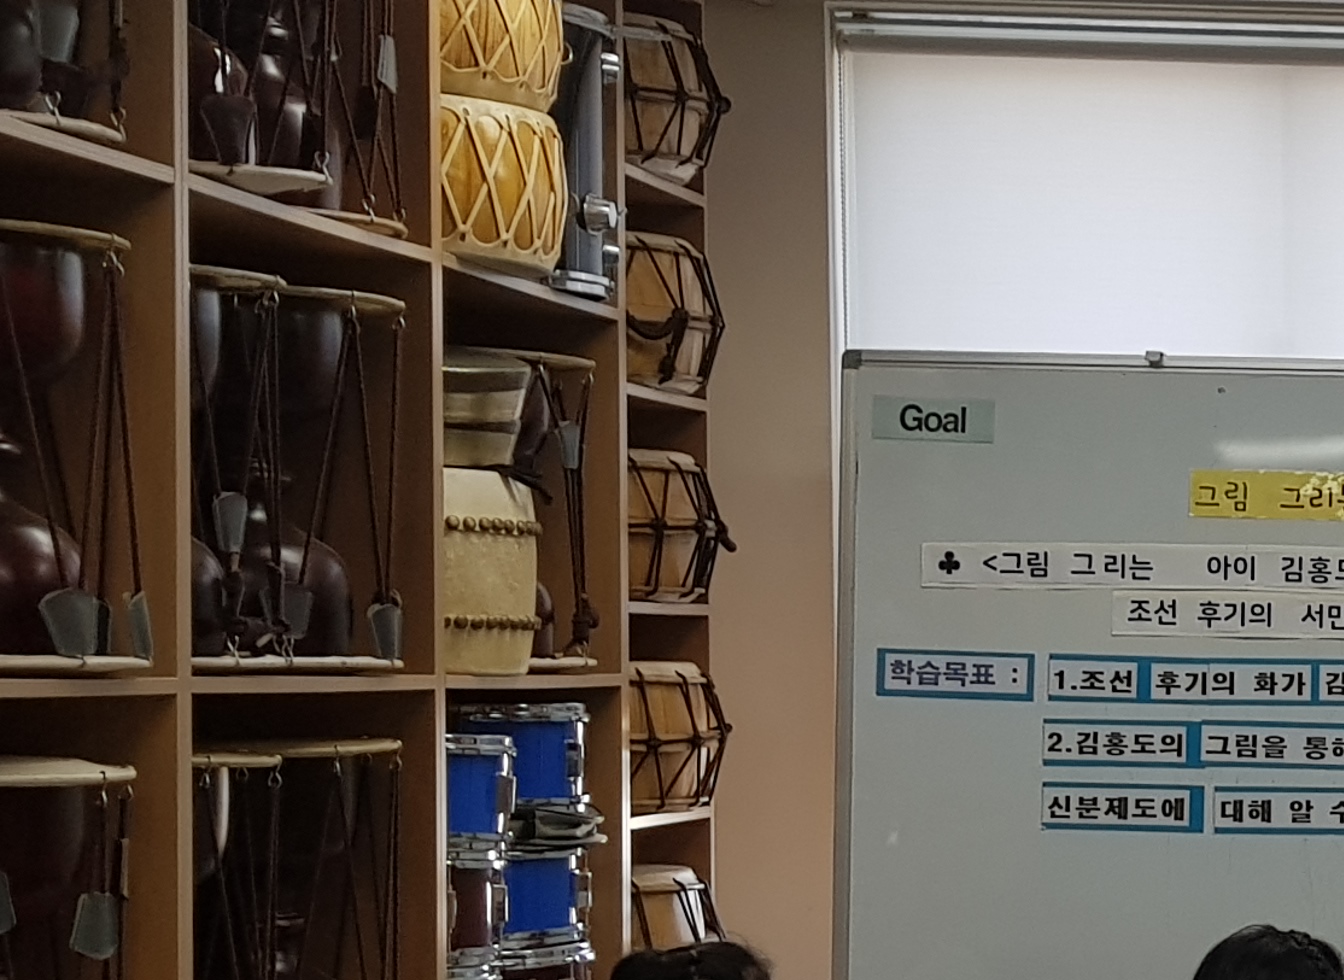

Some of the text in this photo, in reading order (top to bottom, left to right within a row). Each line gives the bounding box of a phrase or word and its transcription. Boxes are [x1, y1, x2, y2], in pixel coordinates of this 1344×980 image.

[900, 404, 967, 434] Goal
[1194, 481, 1248, 512] 그림
[982, 551, 1048, 578] <그림
[1070, 553, 1153, 580] 그리는
[1206, 555, 1256, 581] 아이
[1127, 599, 1177, 626] 조선
[1197, 600, 1272, 628] 후기의
[890, 659, 996, 687] 학습목표
[1054, 669, 1133, 694] 1.조선
[1155, 671, 1235, 696] 후기의
[1254, 671, 1306, 696] 화가
[1047, 731, 1183, 758] 2.김홍도의
[1205, 734, 1287, 760] 그림을
[1047, 795, 1185, 820] 신분제도에
[1220, 799, 1272, 823] 대해
[1290, 799, 1314, 824] 알
